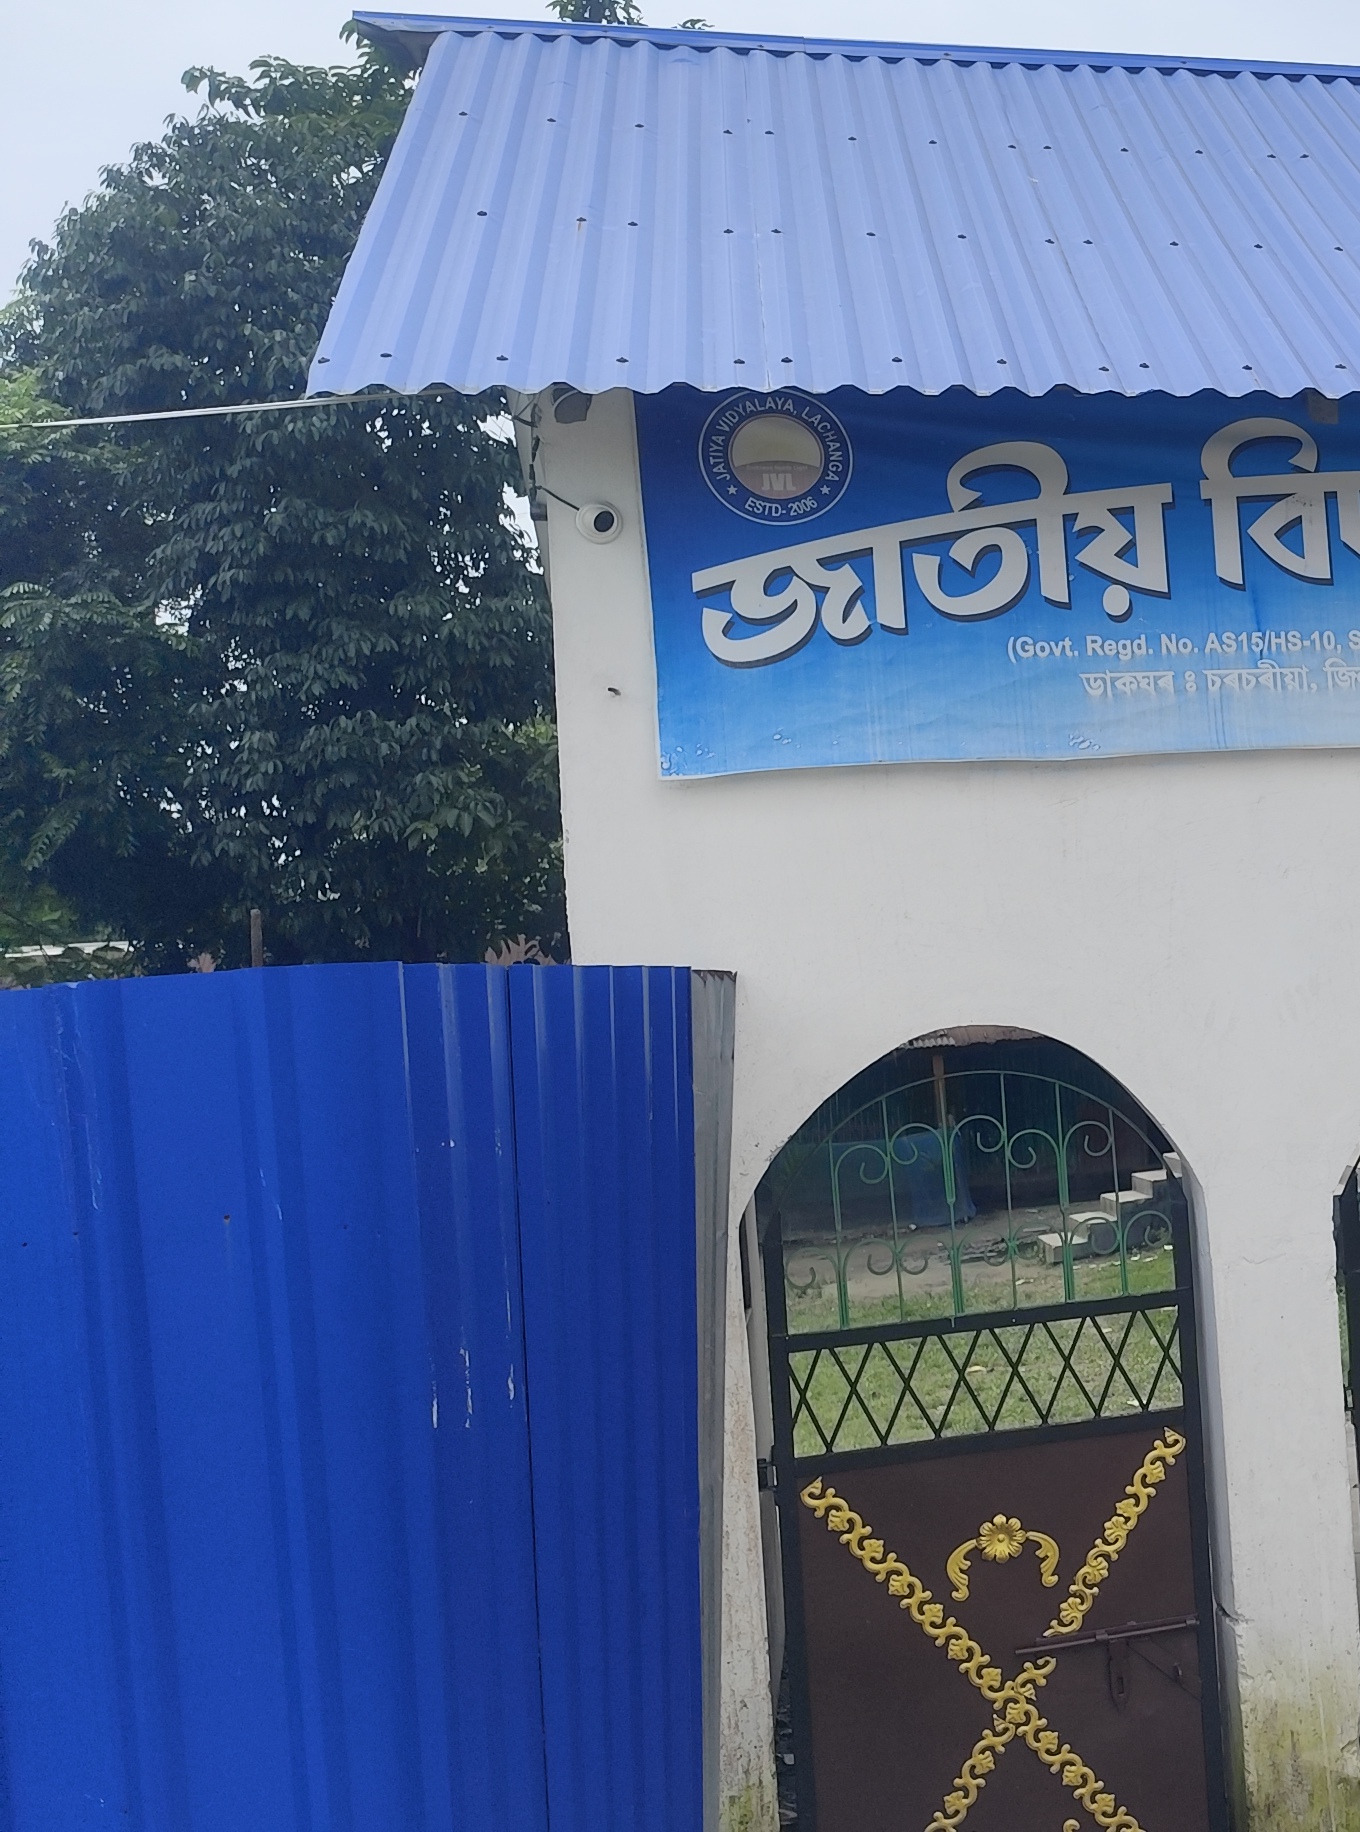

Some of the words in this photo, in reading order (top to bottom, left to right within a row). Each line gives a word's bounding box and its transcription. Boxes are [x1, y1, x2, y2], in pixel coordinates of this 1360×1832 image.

[716, 397, 797, 432] VIDYALAYA,
[709, 435, 730, 480] JATIYA
[802, 407, 843, 482] LACHANGA
[761, 473, 797, 491] JVL
[788, 497, 818, 516] 2006
[692, 440, 1172, 668] জাতীয়
[1007, 636, 1080, 664] (Govt.
[1085, 633, 1154, 661] Regd.
[1160, 633, 1200, 656] No.
[1204, 628, 1343, 656] AS15/HS-10,
